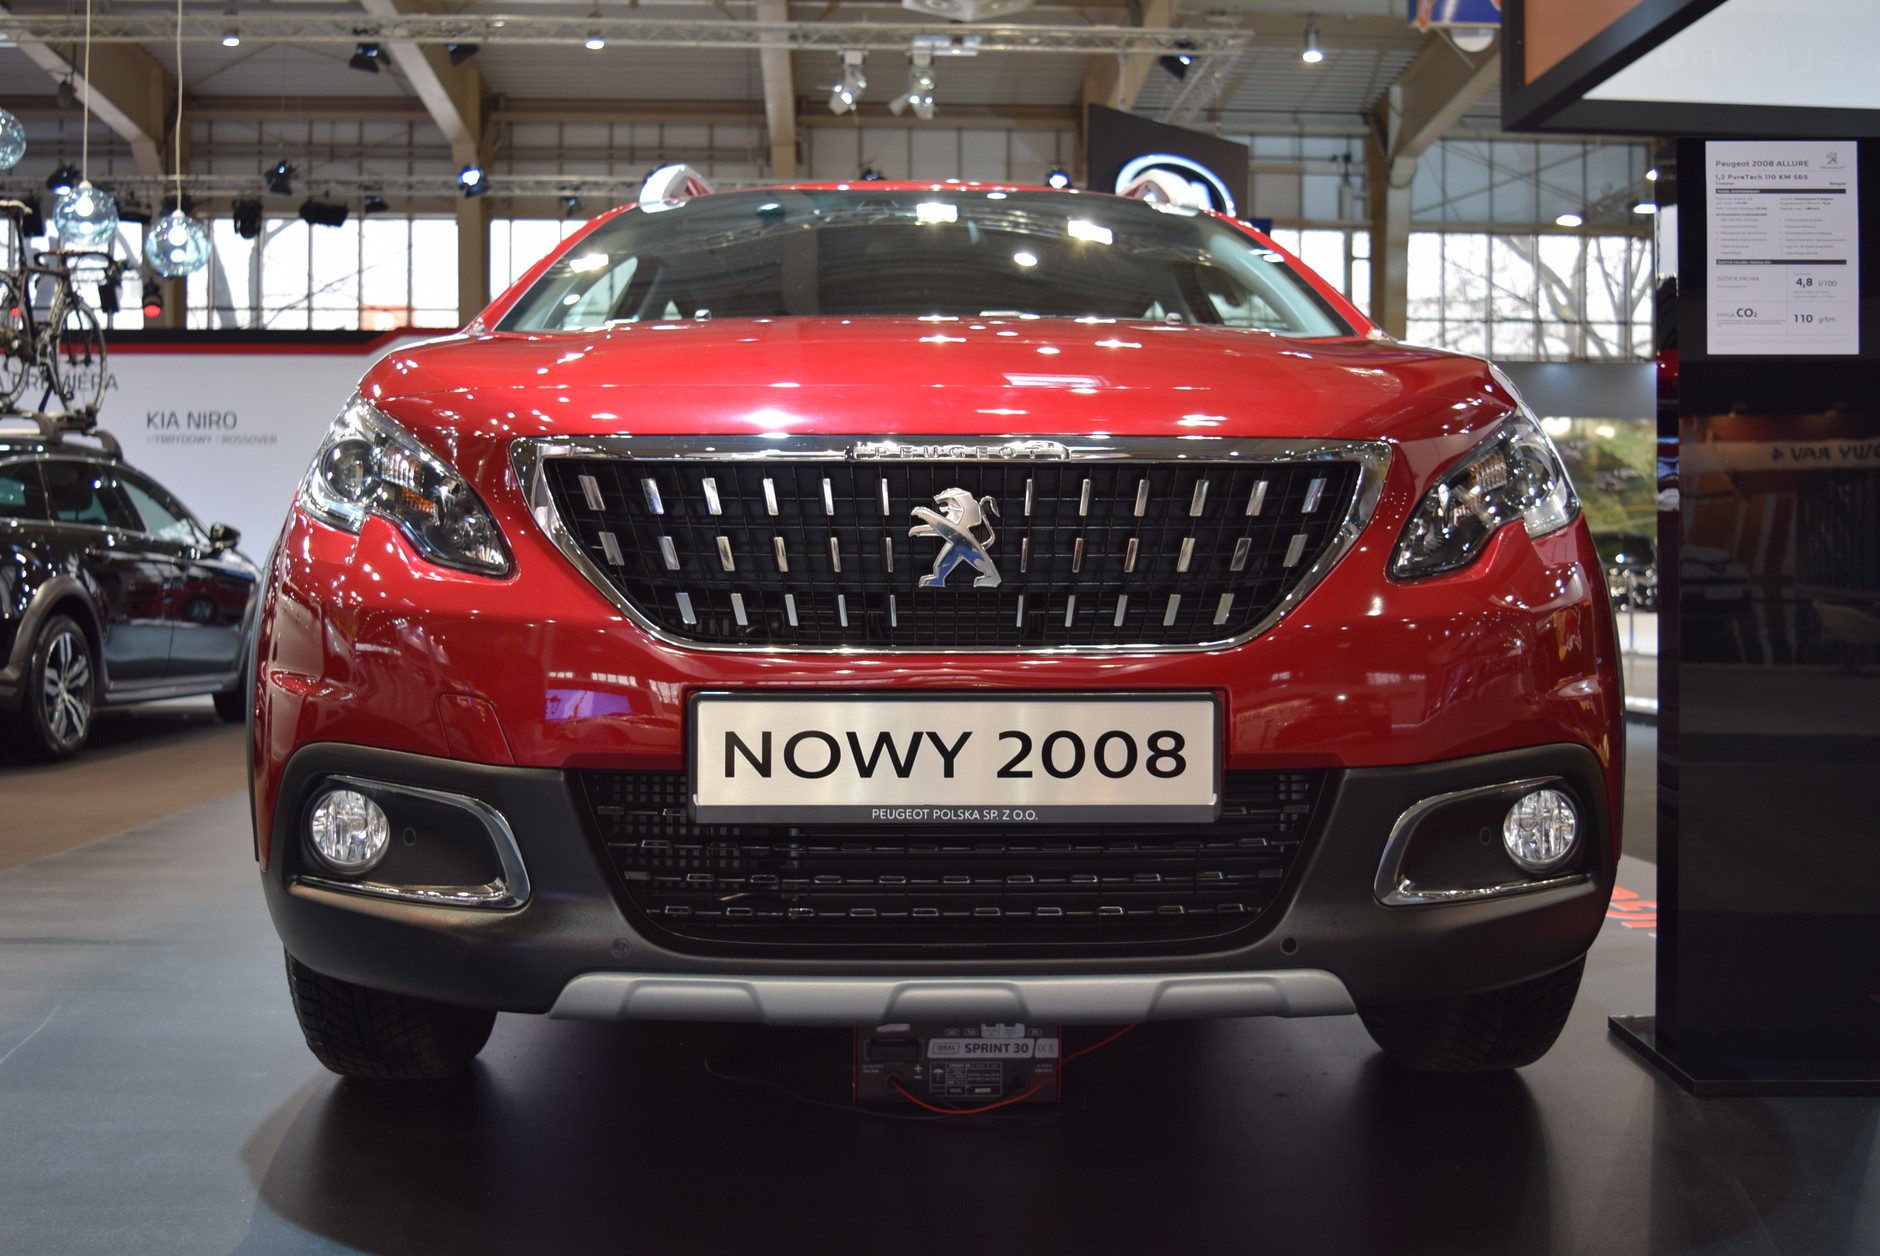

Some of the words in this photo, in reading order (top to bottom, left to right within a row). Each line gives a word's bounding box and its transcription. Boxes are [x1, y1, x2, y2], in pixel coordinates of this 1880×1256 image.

[1715, 160, 1750, 168] Peugeot
[1796, 277, 1813, 288] 4,8
[1794, 314, 1813, 323] 110
[1818, 315, 1837, 324] g/km
[146, 410, 180, 430] KIA
[186, 410, 237, 430] NIRO
[724, 730, 974, 779] NOWY
[996, 730, 1188, 779] 2008
[871, 808, 930, 819] PEUGEOT
[932, 809, 981, 820] POLSKA
[983, 809, 999, 820] SP.
[1002, 809, 1010, 820] Z
[1013, 809, 1038, 820] O.O.
[964, 1042, 1012, 1054] SPRINT
[1013, 1042, 1029, 1054] 30
